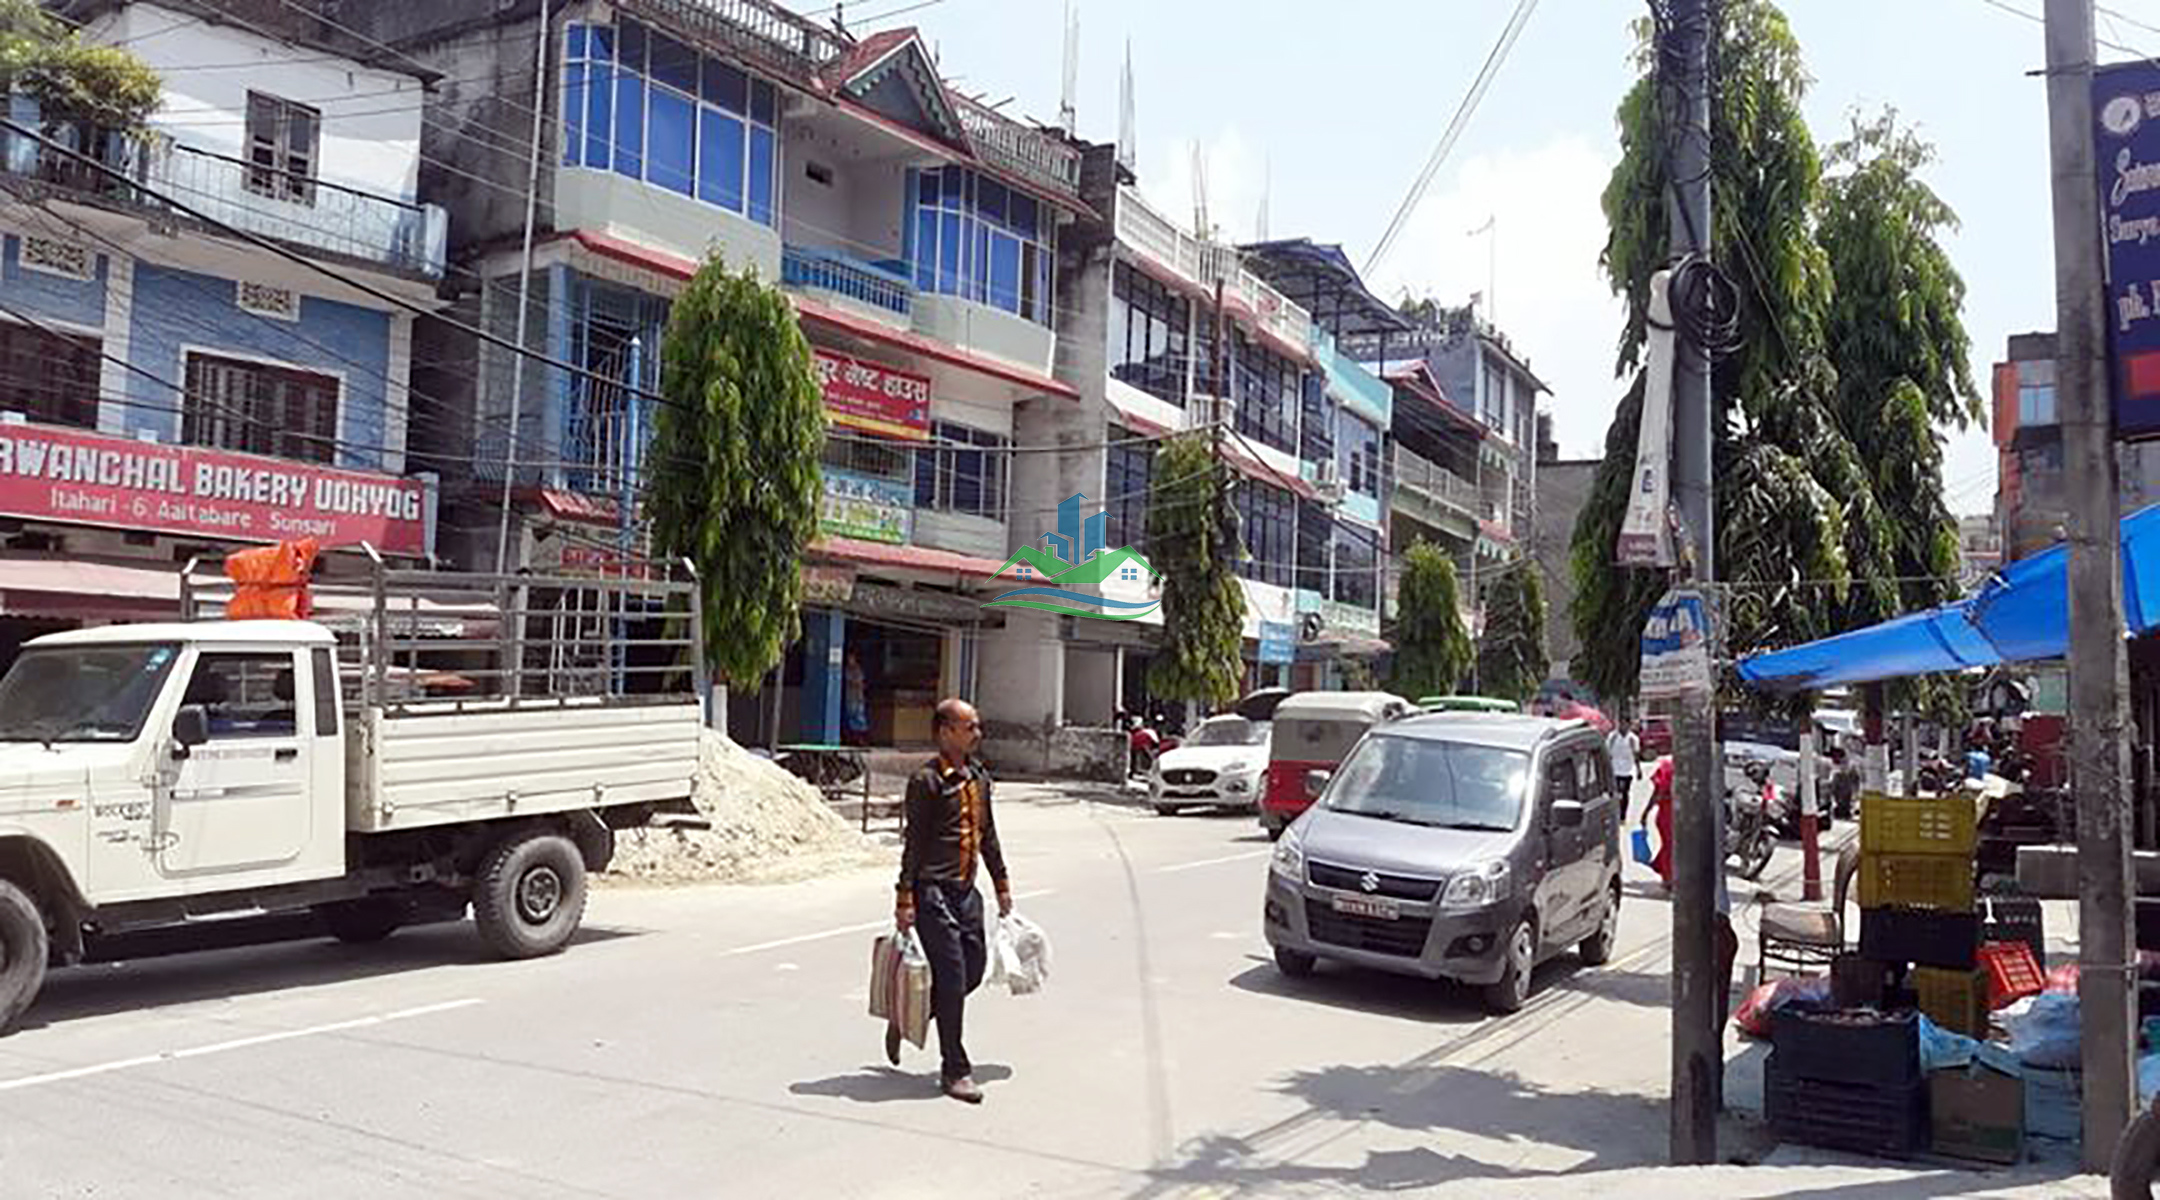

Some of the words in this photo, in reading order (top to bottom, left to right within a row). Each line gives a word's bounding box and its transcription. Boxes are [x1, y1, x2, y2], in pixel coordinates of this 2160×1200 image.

[51, 487, 116, 514] Itahari
[158, 500, 251, 528] Aaitabare
[194, 462, 309, 508] BAKERY
[314, 477, 420, 520] UDHYOG
